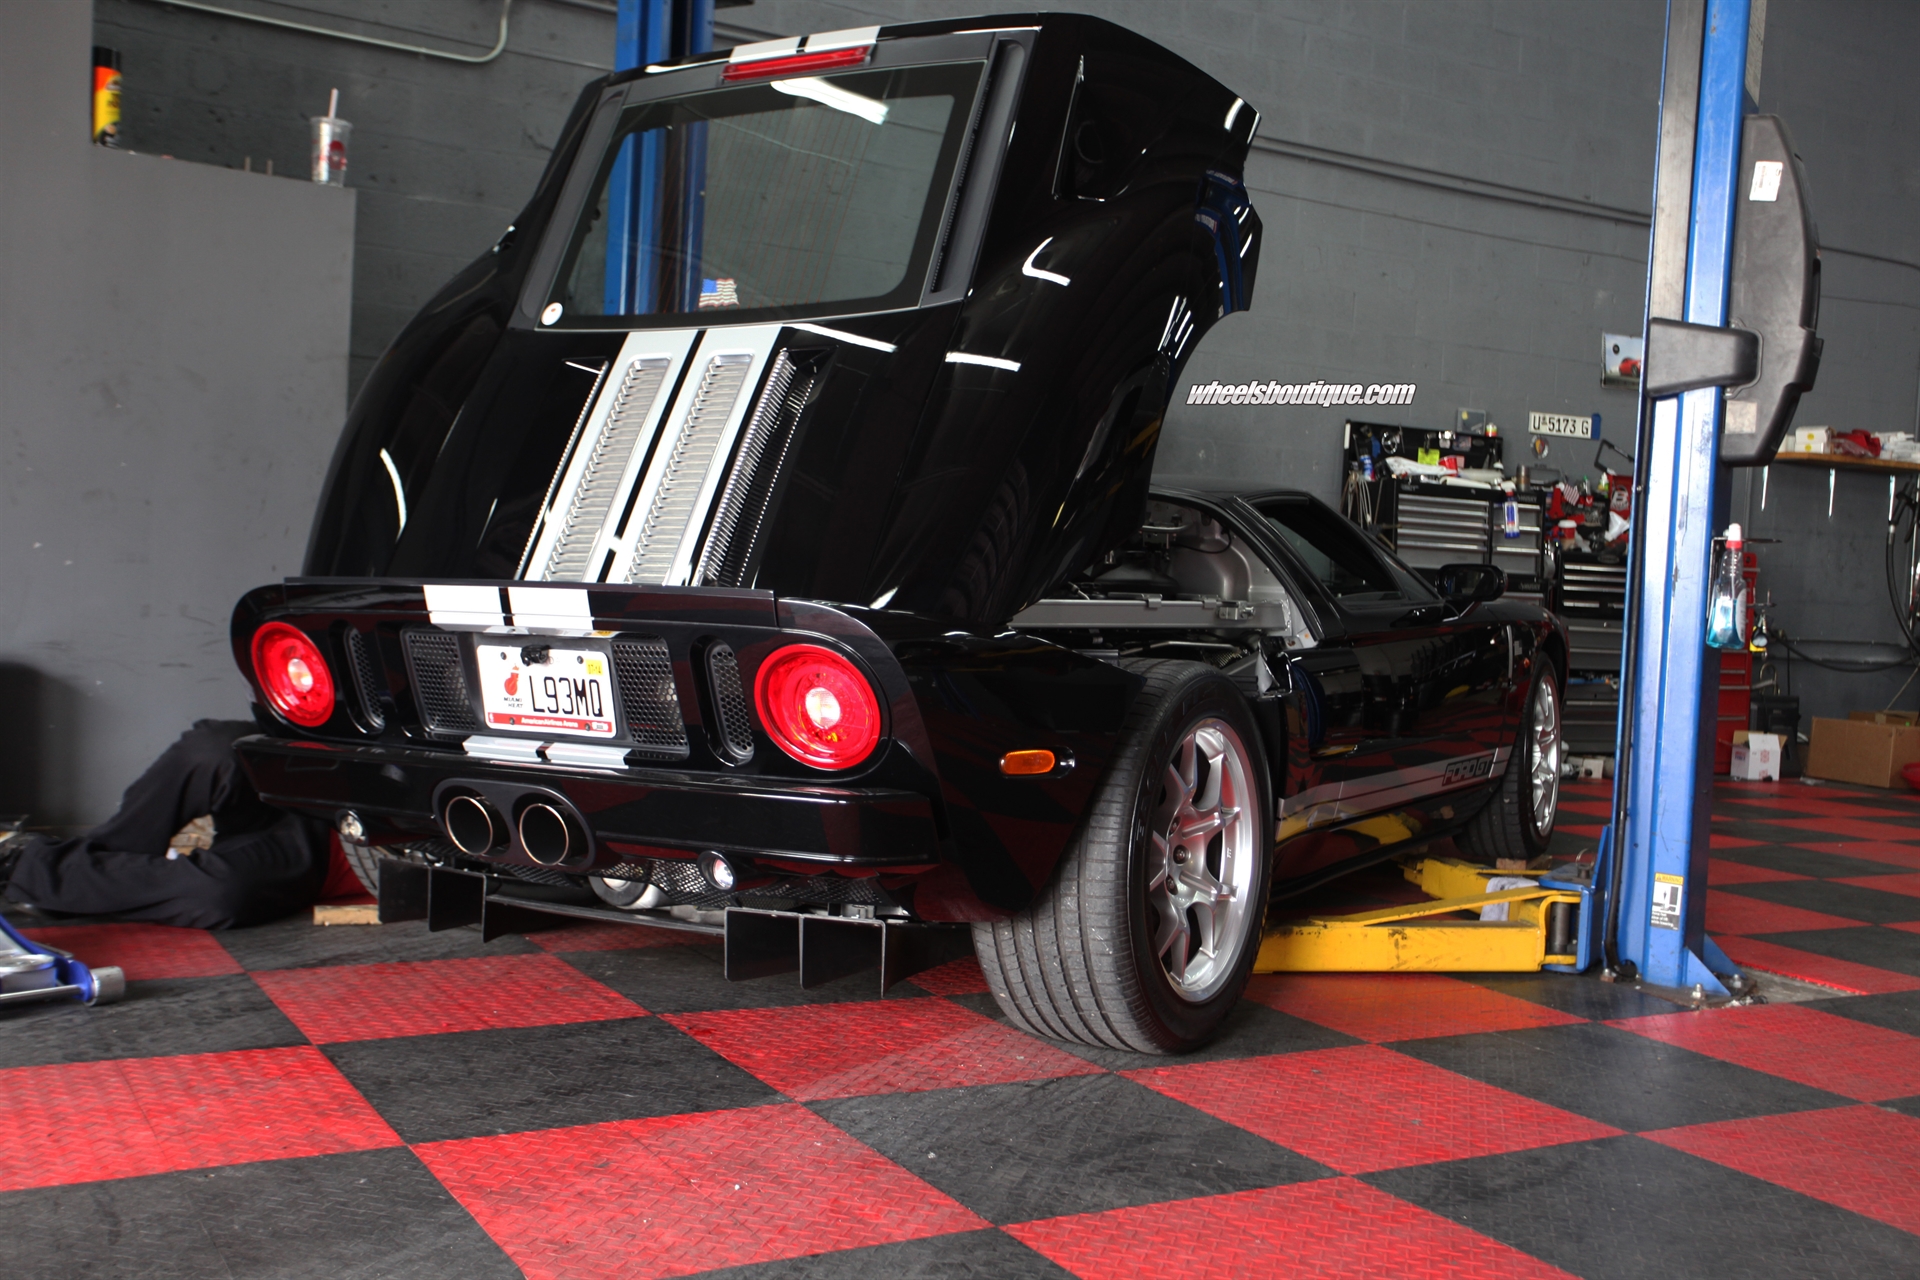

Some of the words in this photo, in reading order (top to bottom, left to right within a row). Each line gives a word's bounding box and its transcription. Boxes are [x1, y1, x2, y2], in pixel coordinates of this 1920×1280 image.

[1532, 415, 1541, 430] U
[1548, 416, 1576, 434] 5173
[1581, 420, 1589, 435] G
[529, 675, 604, 718] L93MQ
[1444, 760, 1477, 784] FORD
[1475, 755, 1493, 776] GT
